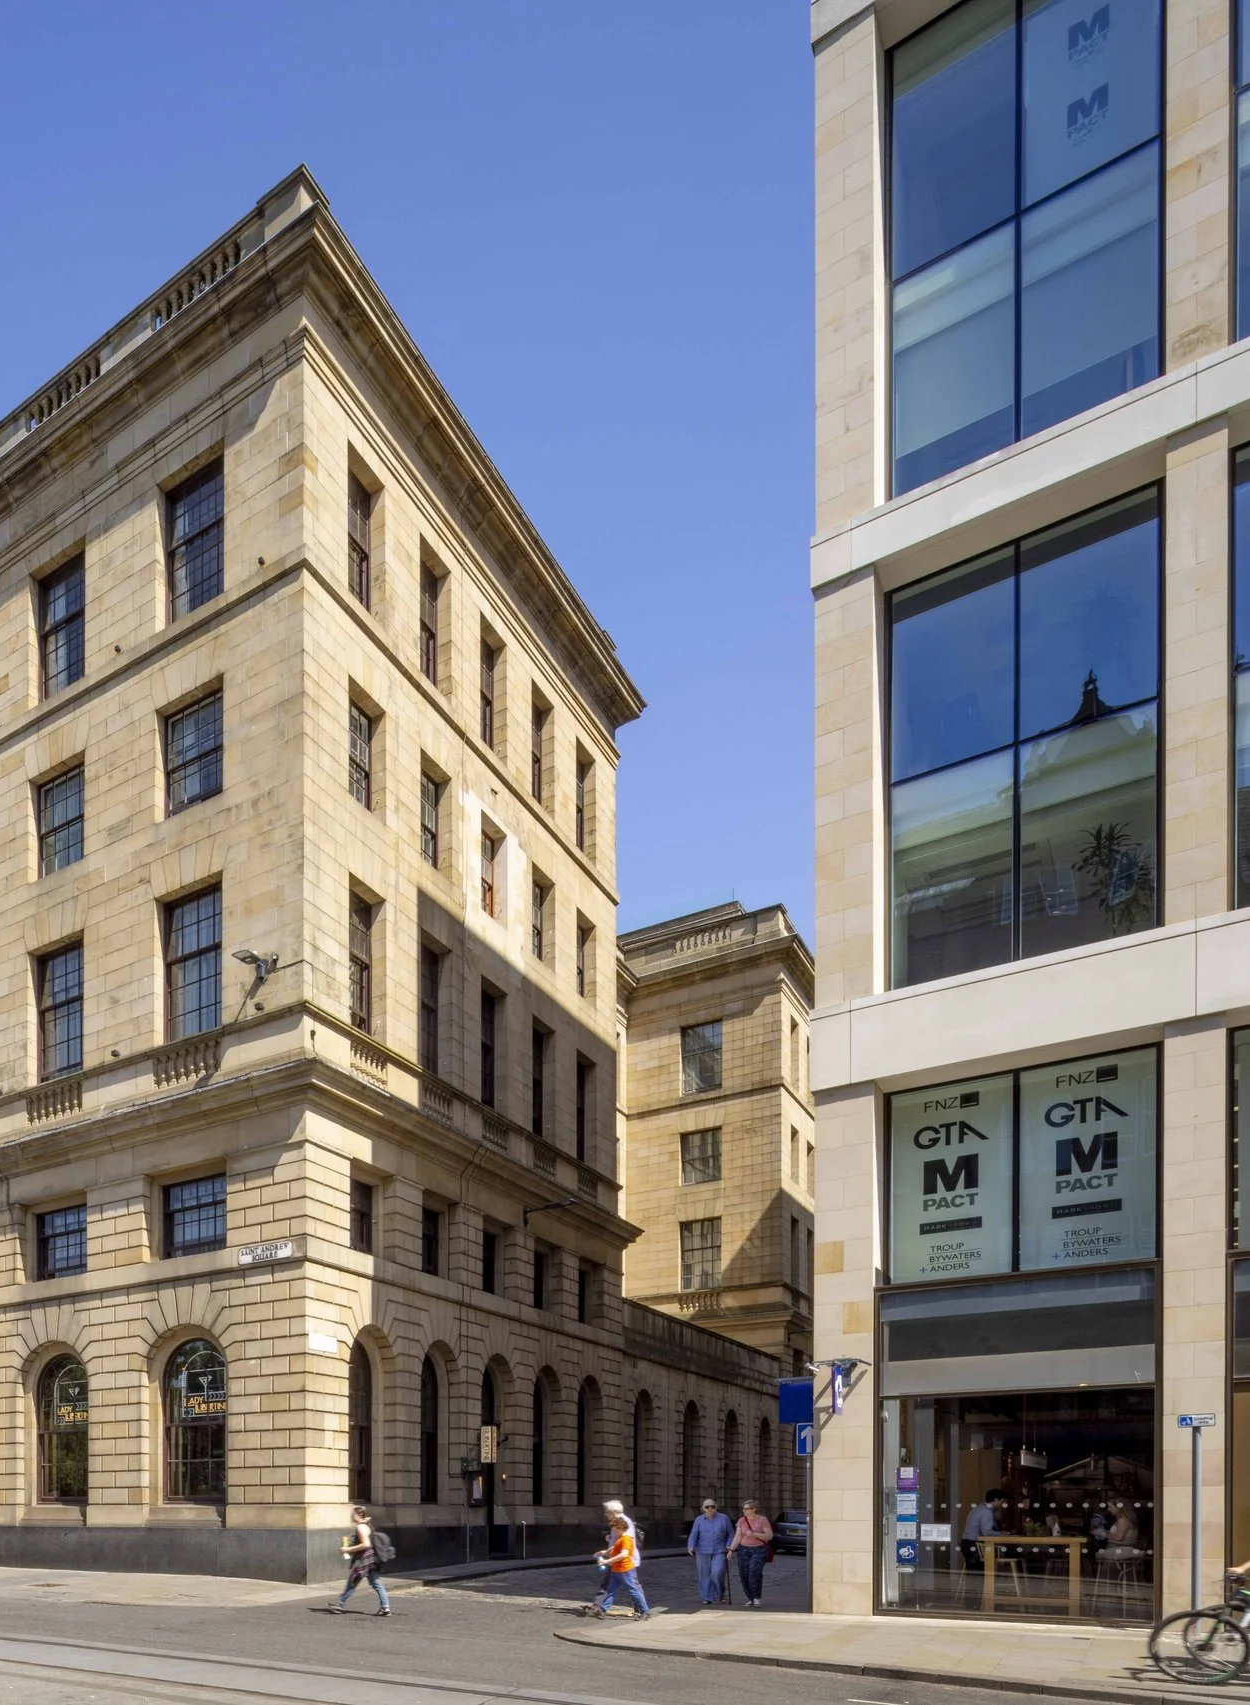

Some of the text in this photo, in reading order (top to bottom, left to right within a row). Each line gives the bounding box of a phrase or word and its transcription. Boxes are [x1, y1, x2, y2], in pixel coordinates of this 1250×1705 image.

[1068, 3, 1110, 51] M
[1067, 81, 1109, 129] M
[1056, 1069, 1095, 1089] FNZ
[924, 1096, 959, 1113] FNZ
[1044, 1096, 1130, 1128] GTA
[913, 1120, 990, 1150] GTA
[1056, 1131, 1118, 1176] M
[923, 1153, 979, 1195] M
[1056, 1173, 1118, 1194] PACT
[922, 1192, 979, 1212] PACT
[1064, 1226, 1102, 1238] TROUP
[240, 1242, 290, 1256] SAINT ANDREW
[930, 1242, 965, 1253] TROUP
[1063, 1235, 1121, 1249] BYWATERS
[252, 1250, 278, 1261] SQUARE
[929, 1250, 982, 1263] BYWATERS
[1063, 1247, 1108, 1259] ANDERS
[930, 1262, 970, 1273] ANDERS
[57, 1405, 73, 1414] LADY
